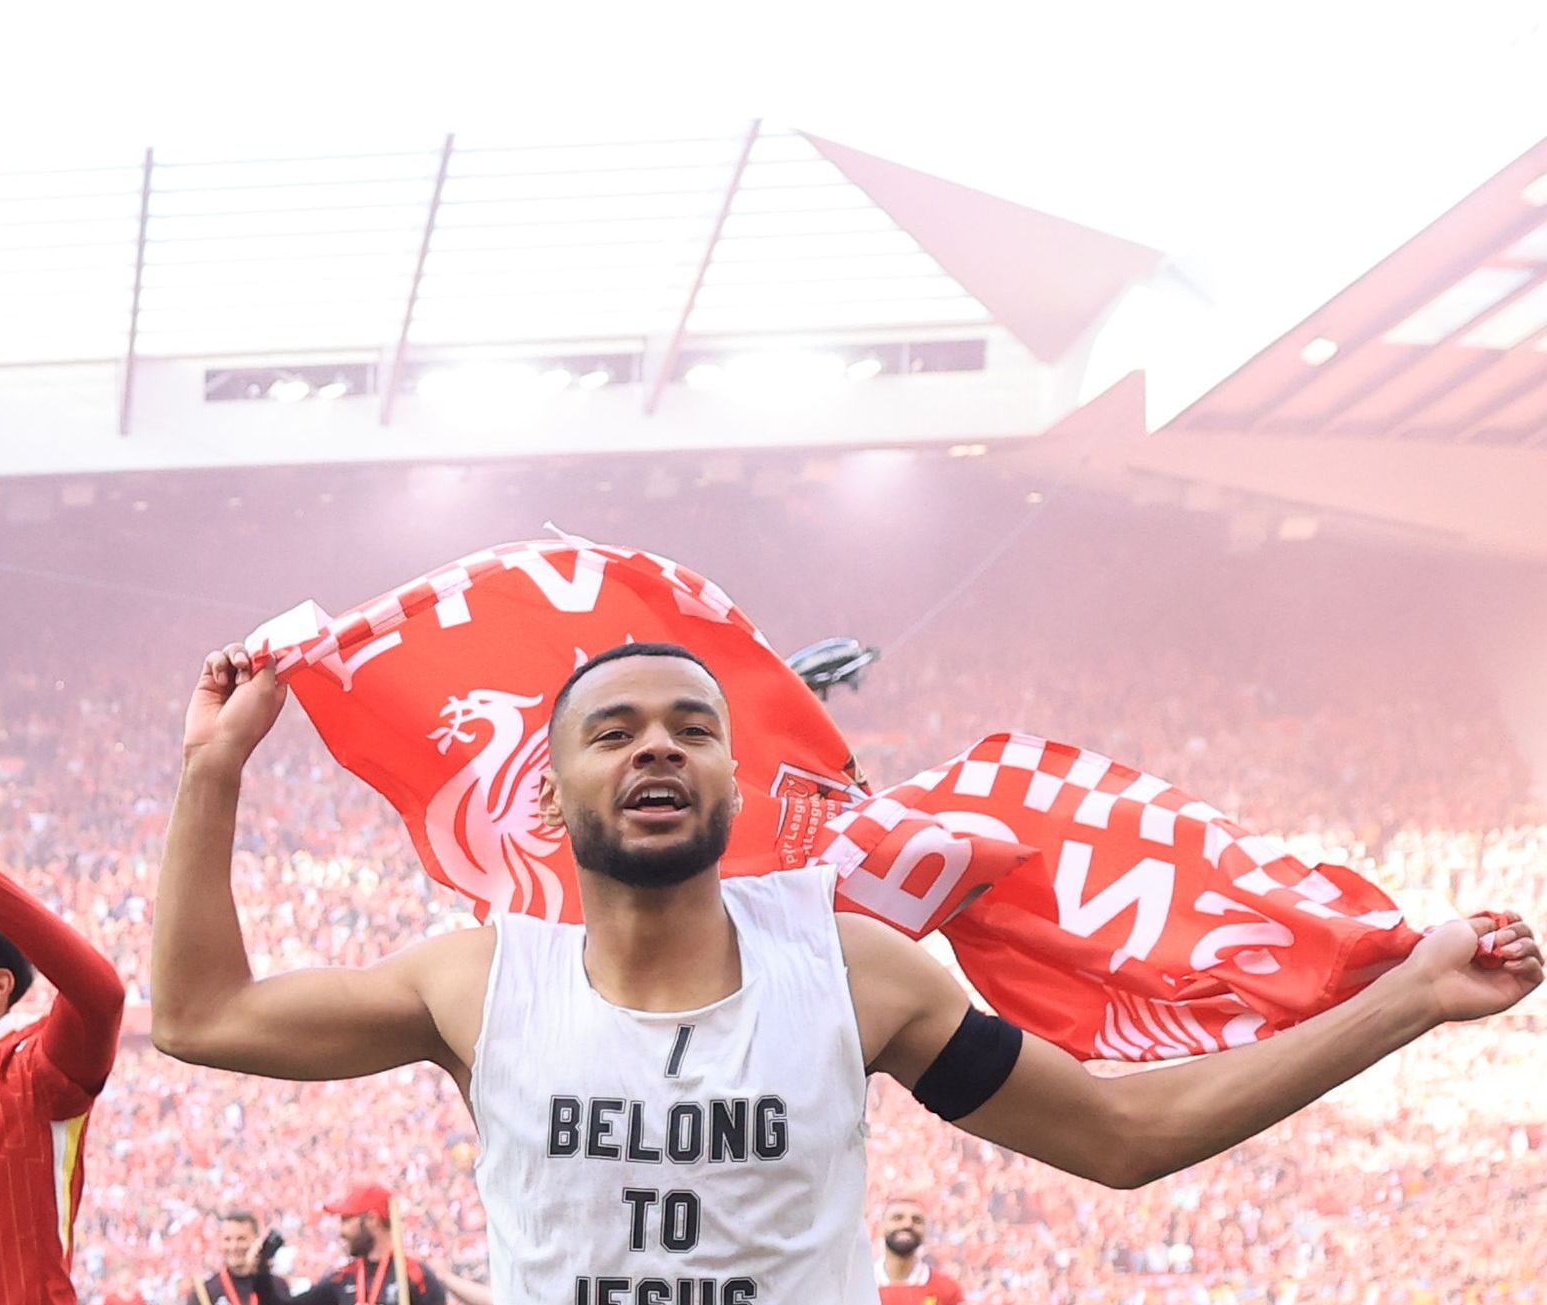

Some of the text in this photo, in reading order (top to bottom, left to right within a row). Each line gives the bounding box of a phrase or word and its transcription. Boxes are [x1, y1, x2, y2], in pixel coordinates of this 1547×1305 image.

[664, 1024, 695, 1078] I
[547, 1094, 789, 1164] BELONG
[622, 1186, 701, 1253] TO
